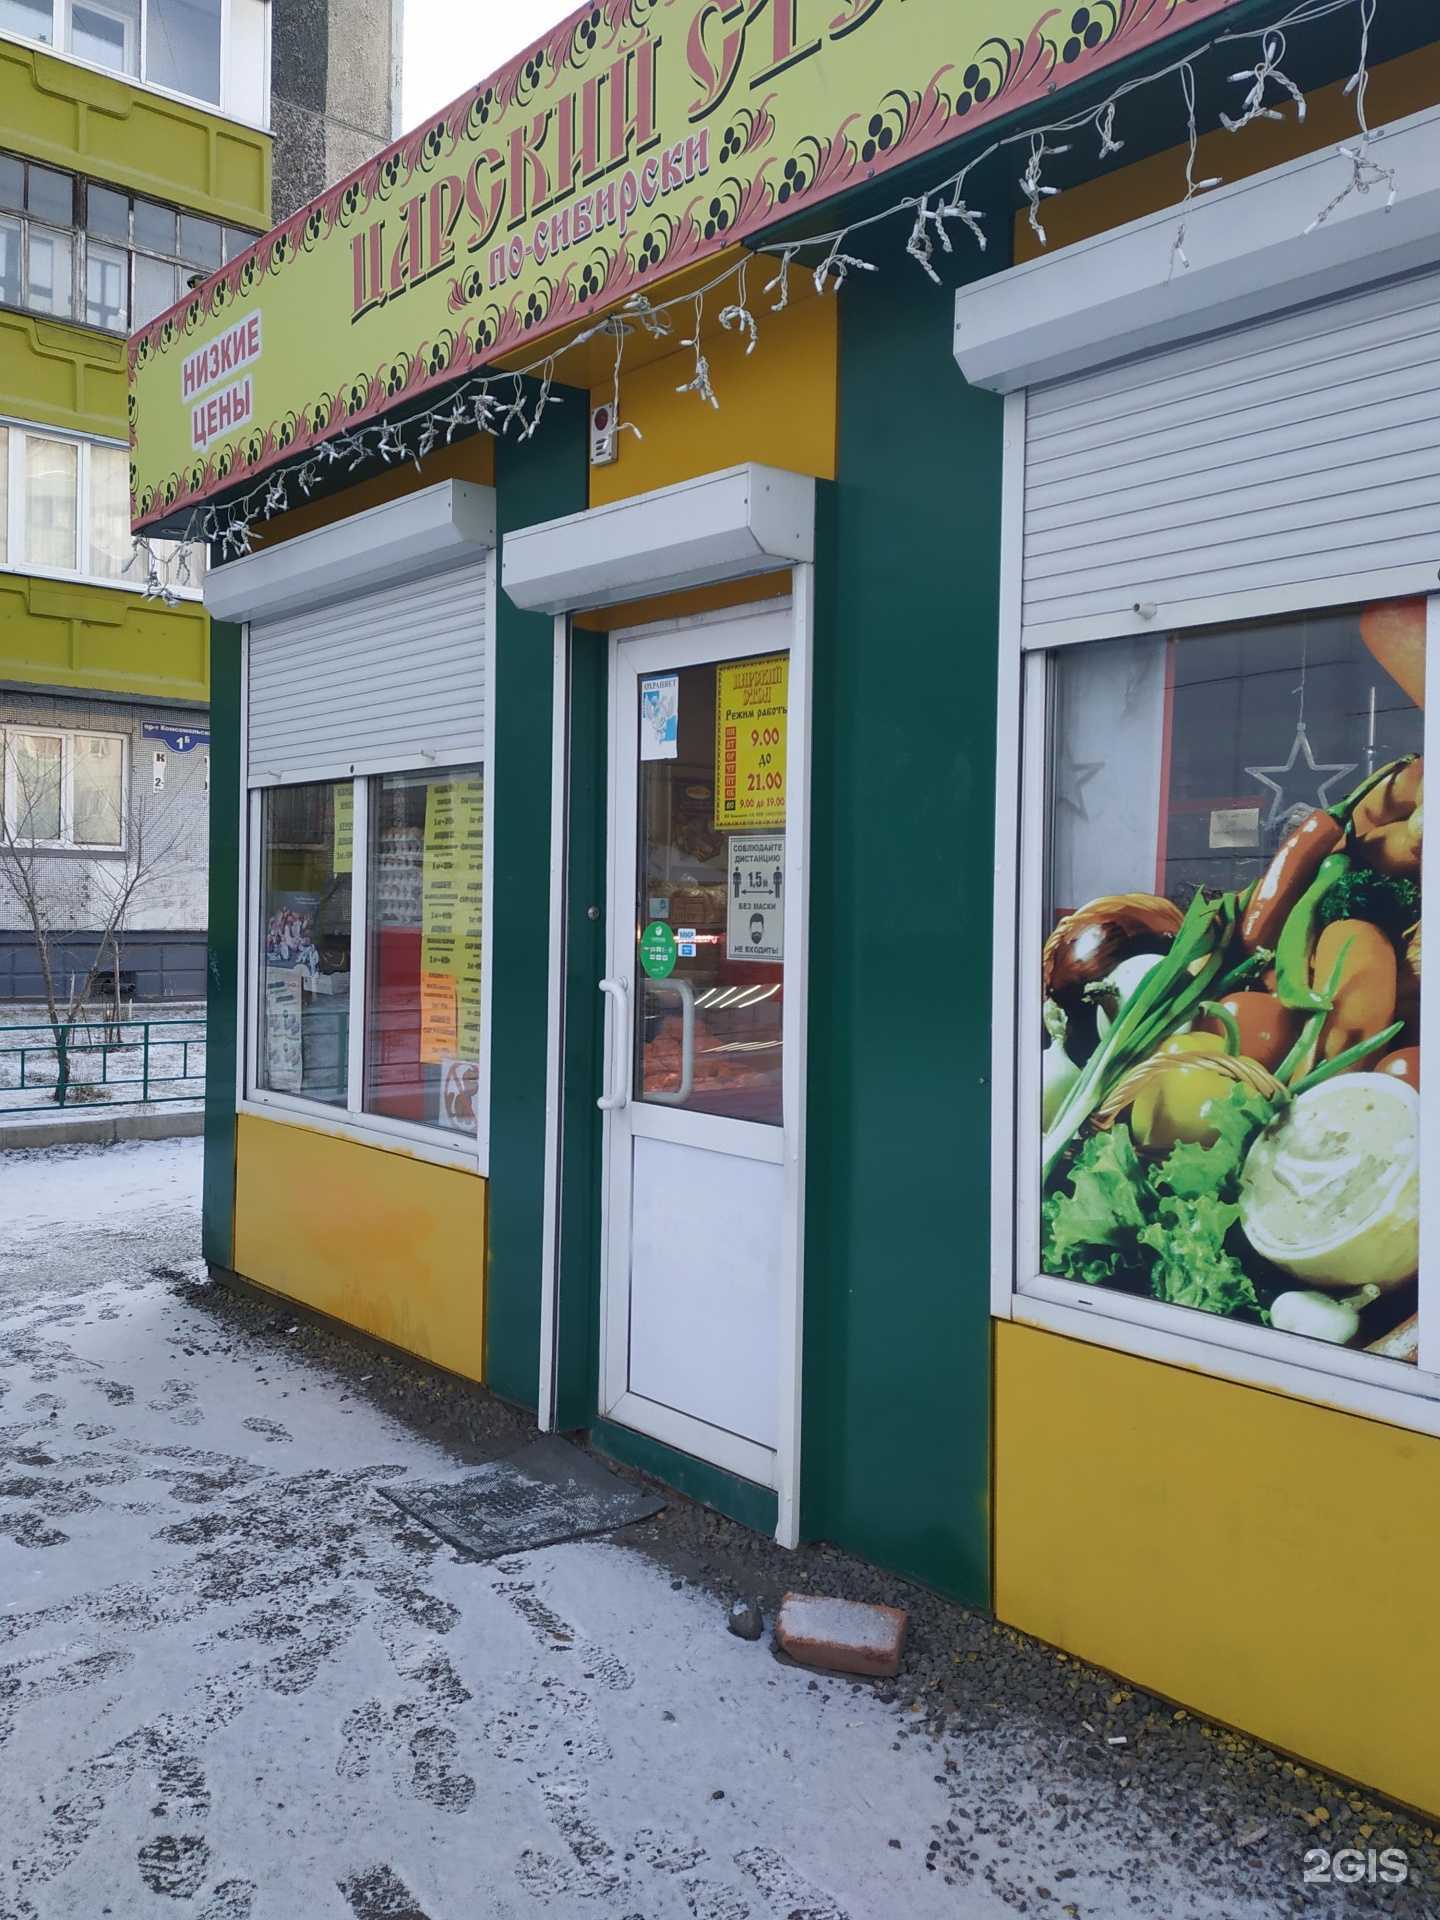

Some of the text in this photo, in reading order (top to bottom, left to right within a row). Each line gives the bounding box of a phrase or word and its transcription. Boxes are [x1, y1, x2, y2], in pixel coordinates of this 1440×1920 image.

[350, 26, 662, 325] ЦАРСКИЙ
[183, 316, 259, 397] НИЗКИЕ
[193, 379, 251, 446] ЦЕНЫ
[751, 727, 780, 747] 9.00
[747, 771, 783, 791] 21.00
[733, 843, 782, 852] СОБЛЮДАЙТЕ
[735, 854, 781, 864] ДИСТАНЦИЮ
[738, 902, 776, 910] БЕЗ МАСКИ
[734, 945, 743, 953] НЕ
